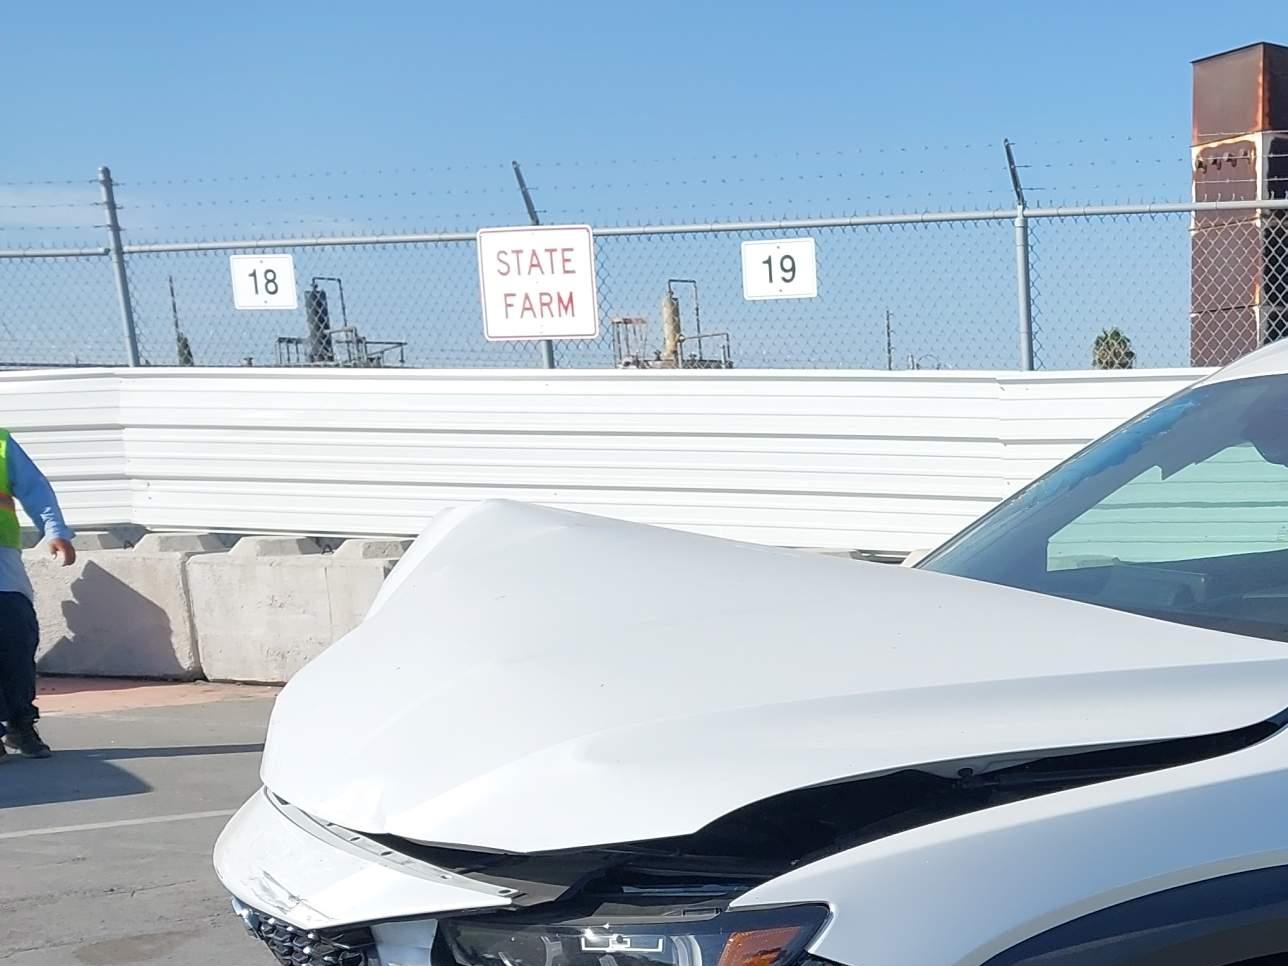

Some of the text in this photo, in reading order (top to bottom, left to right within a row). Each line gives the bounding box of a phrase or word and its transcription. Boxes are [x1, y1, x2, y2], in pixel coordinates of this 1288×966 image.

[496, 247, 577, 276] STATE
[762, 254, 797, 283] 19
[248, 269, 279, 295] 18
[503, 291, 576, 319] FARM
